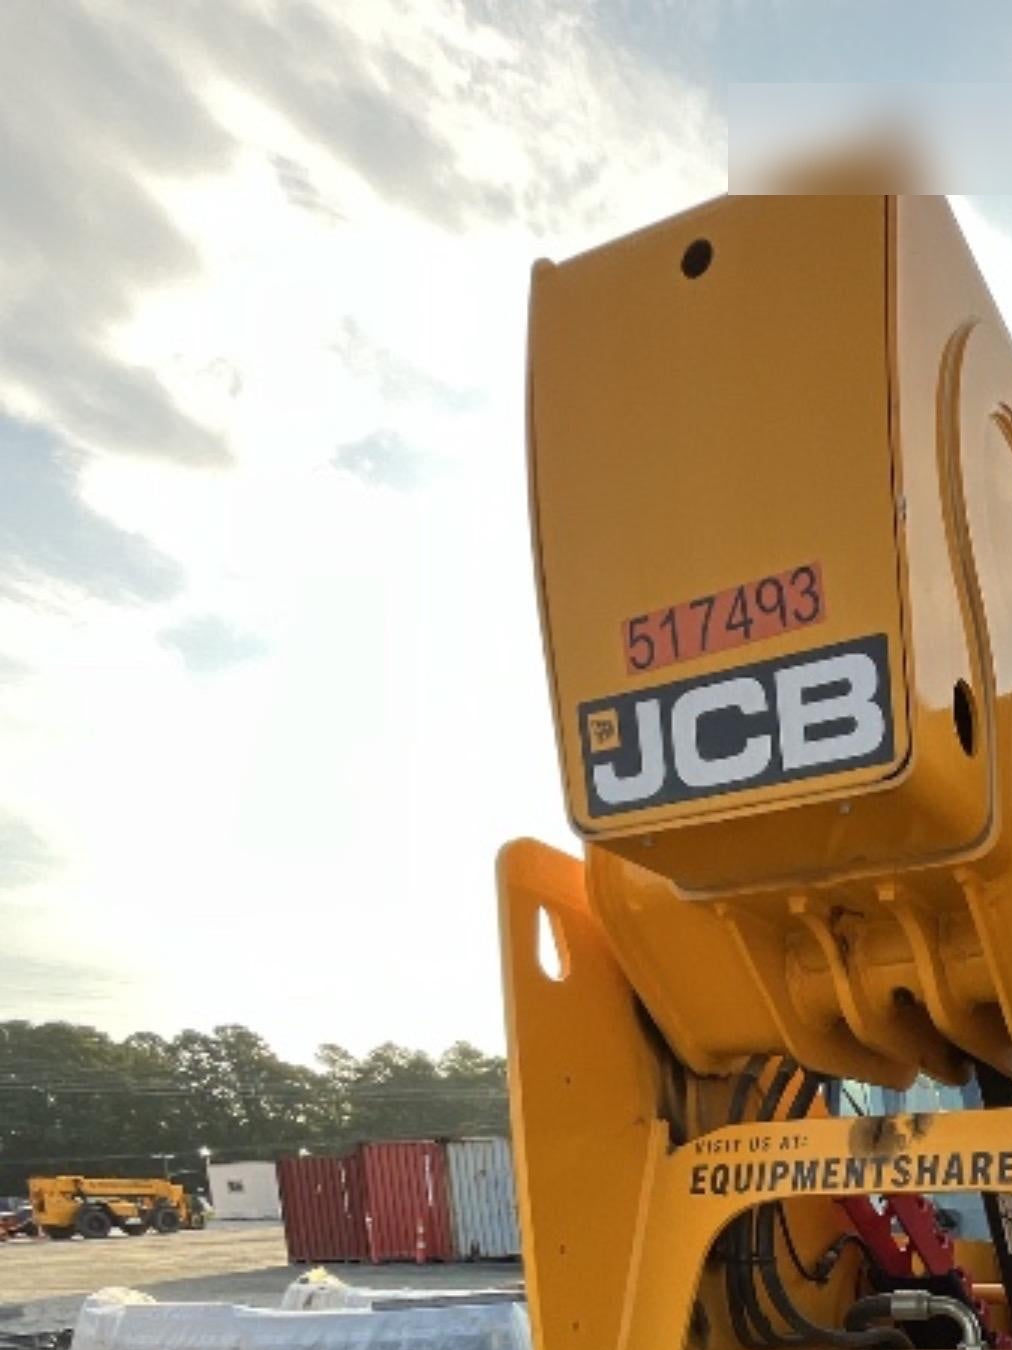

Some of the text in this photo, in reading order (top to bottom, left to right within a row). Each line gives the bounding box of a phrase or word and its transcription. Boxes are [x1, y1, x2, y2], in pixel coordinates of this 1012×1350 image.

[627, 565, 821, 670] 517493
[592, 652, 886, 805] JCB
[695, 1139, 740, 1155] VISIT
[749, 1136, 771, 1152] US
